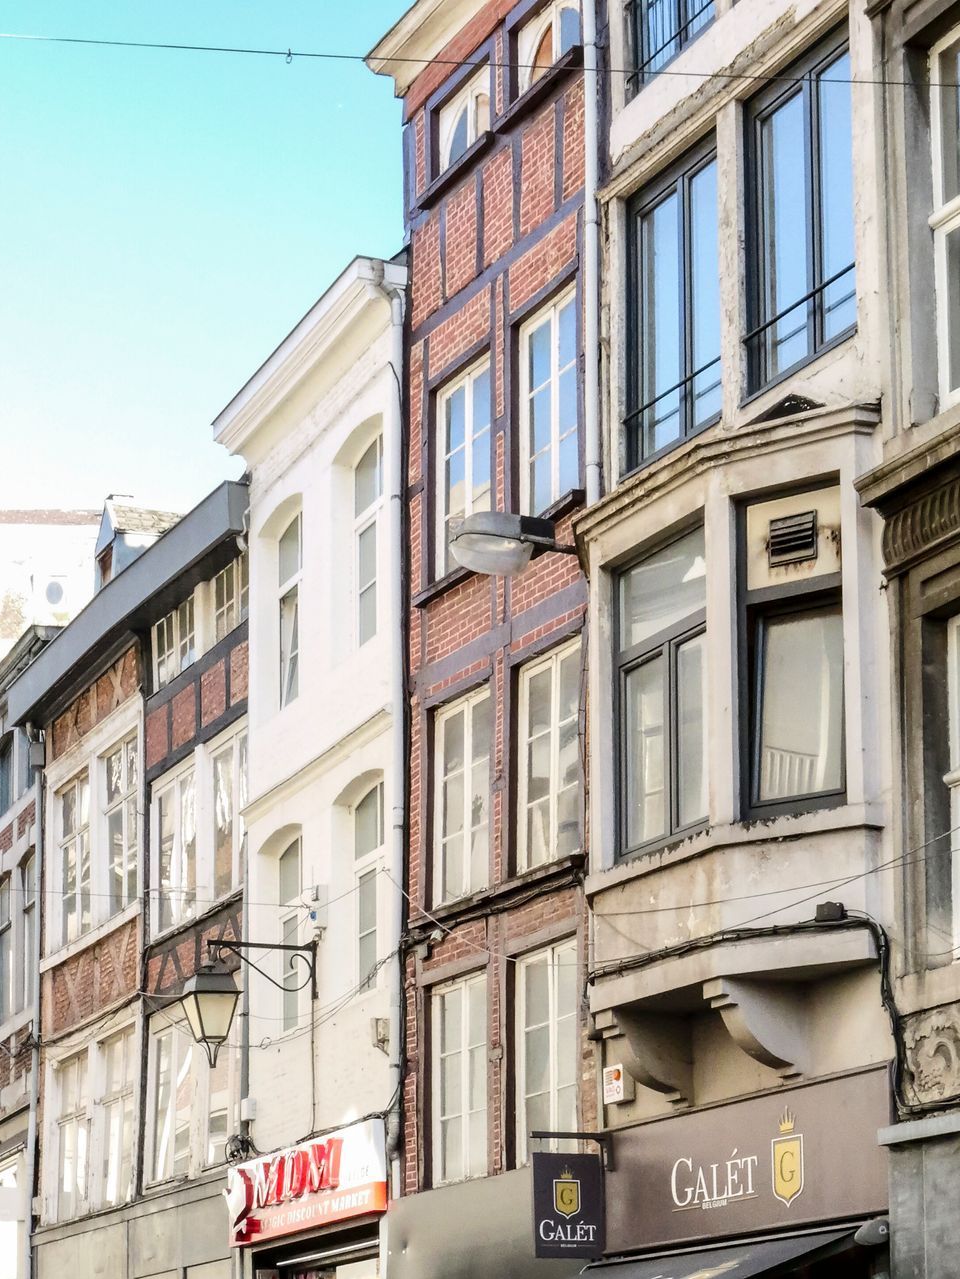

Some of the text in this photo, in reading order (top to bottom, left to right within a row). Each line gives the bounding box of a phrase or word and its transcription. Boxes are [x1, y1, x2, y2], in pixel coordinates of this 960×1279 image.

[779, 1151, 796, 1183] G
[331, 1188, 372, 1214] MARKET
[560, 1187, 574, 1206] G
